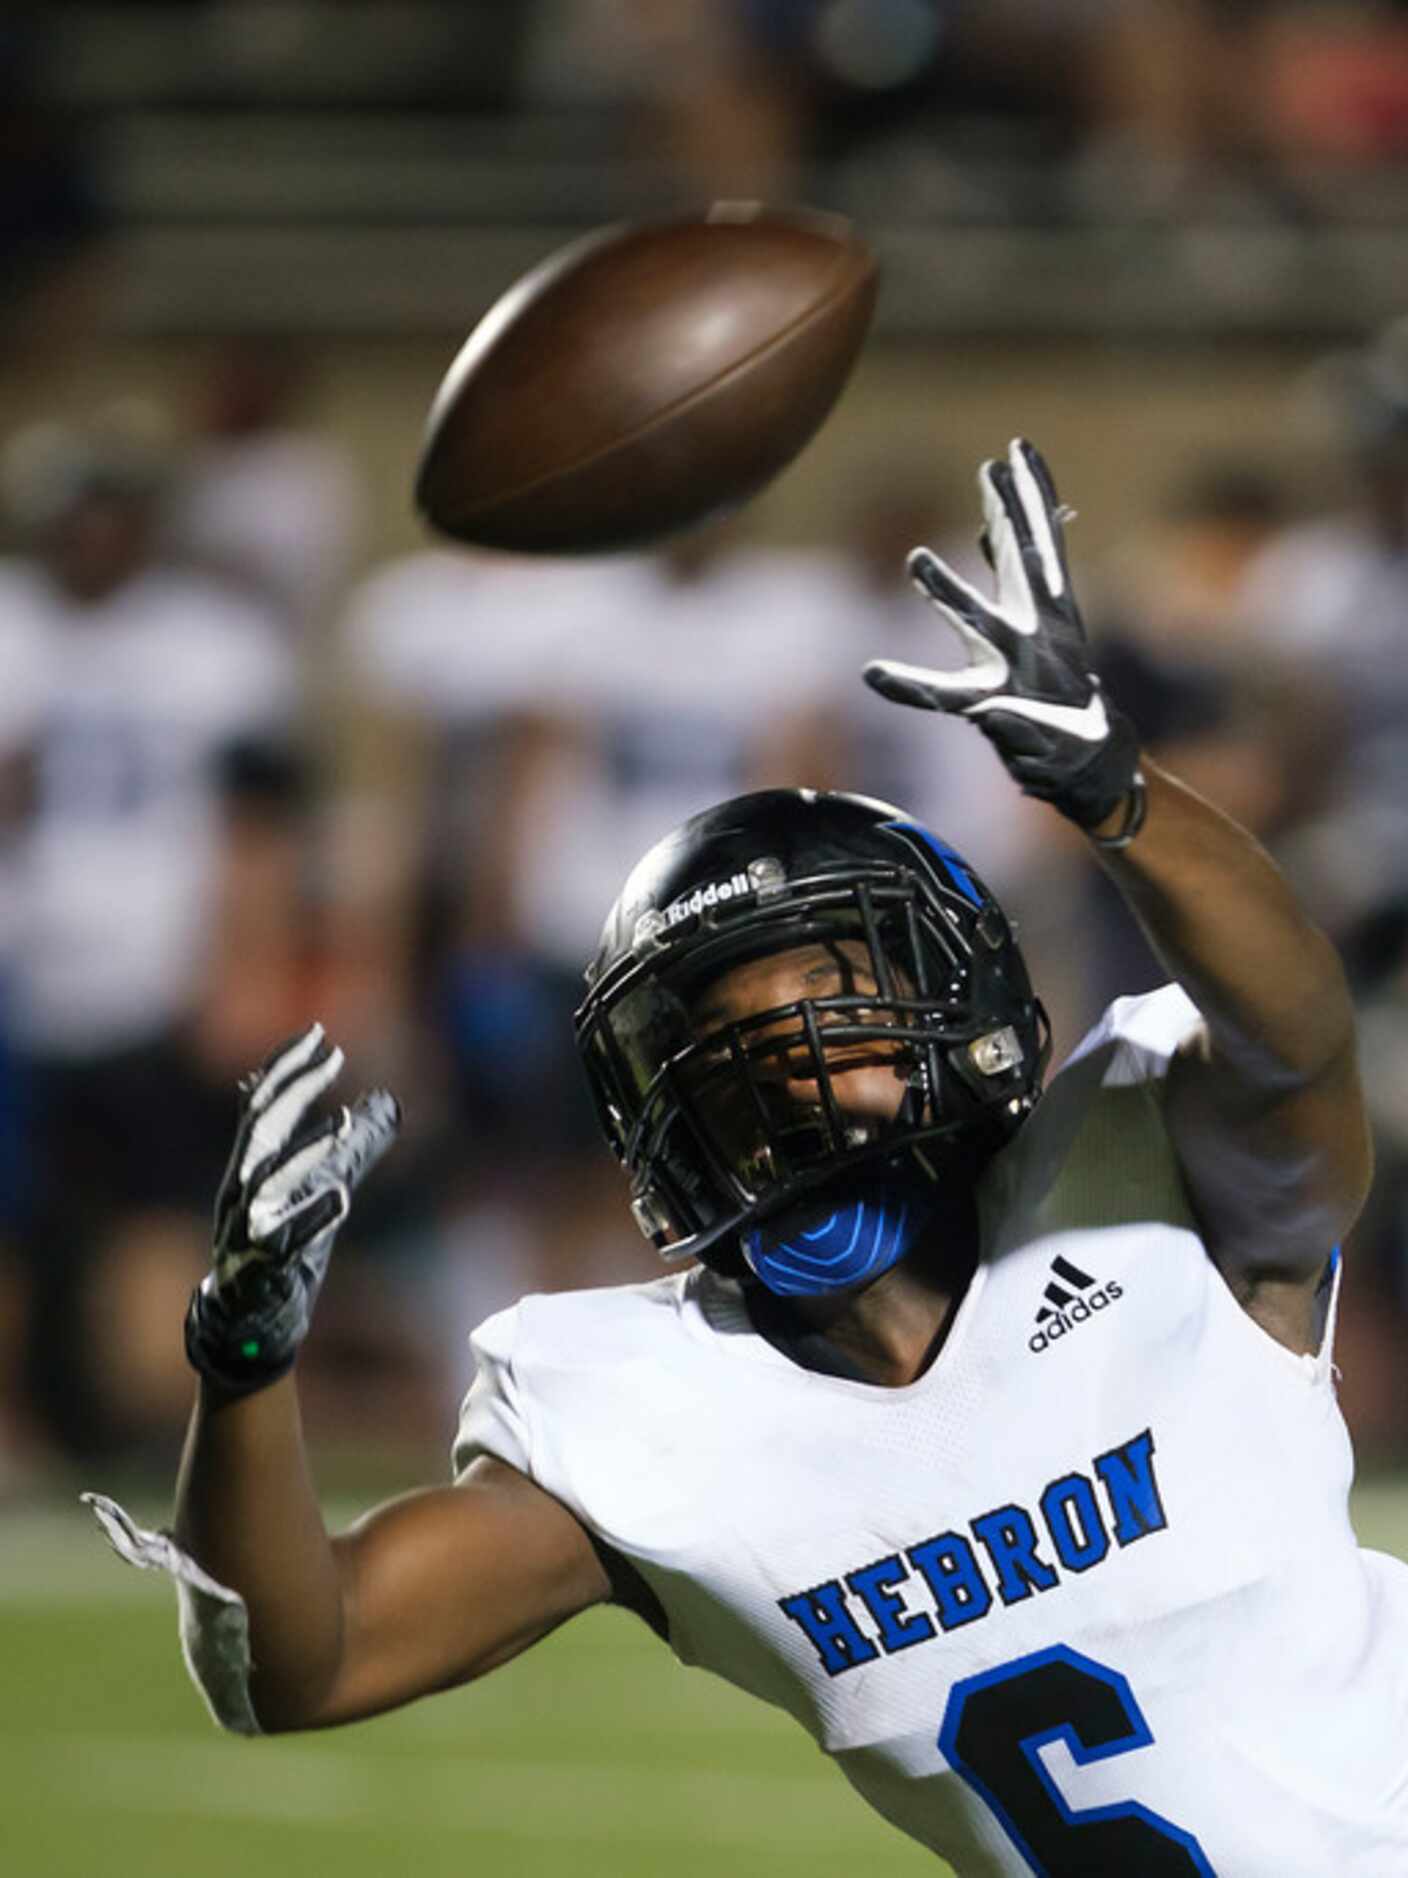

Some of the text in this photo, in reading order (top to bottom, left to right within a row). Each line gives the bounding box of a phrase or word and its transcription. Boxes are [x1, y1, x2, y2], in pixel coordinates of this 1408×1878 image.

[665, 872, 750, 926] Riddell
[1028, 1280, 1124, 1354] adidas
[776, 1426, 1169, 1678] HEBRON
[936, 1642, 1219, 1878] 6
